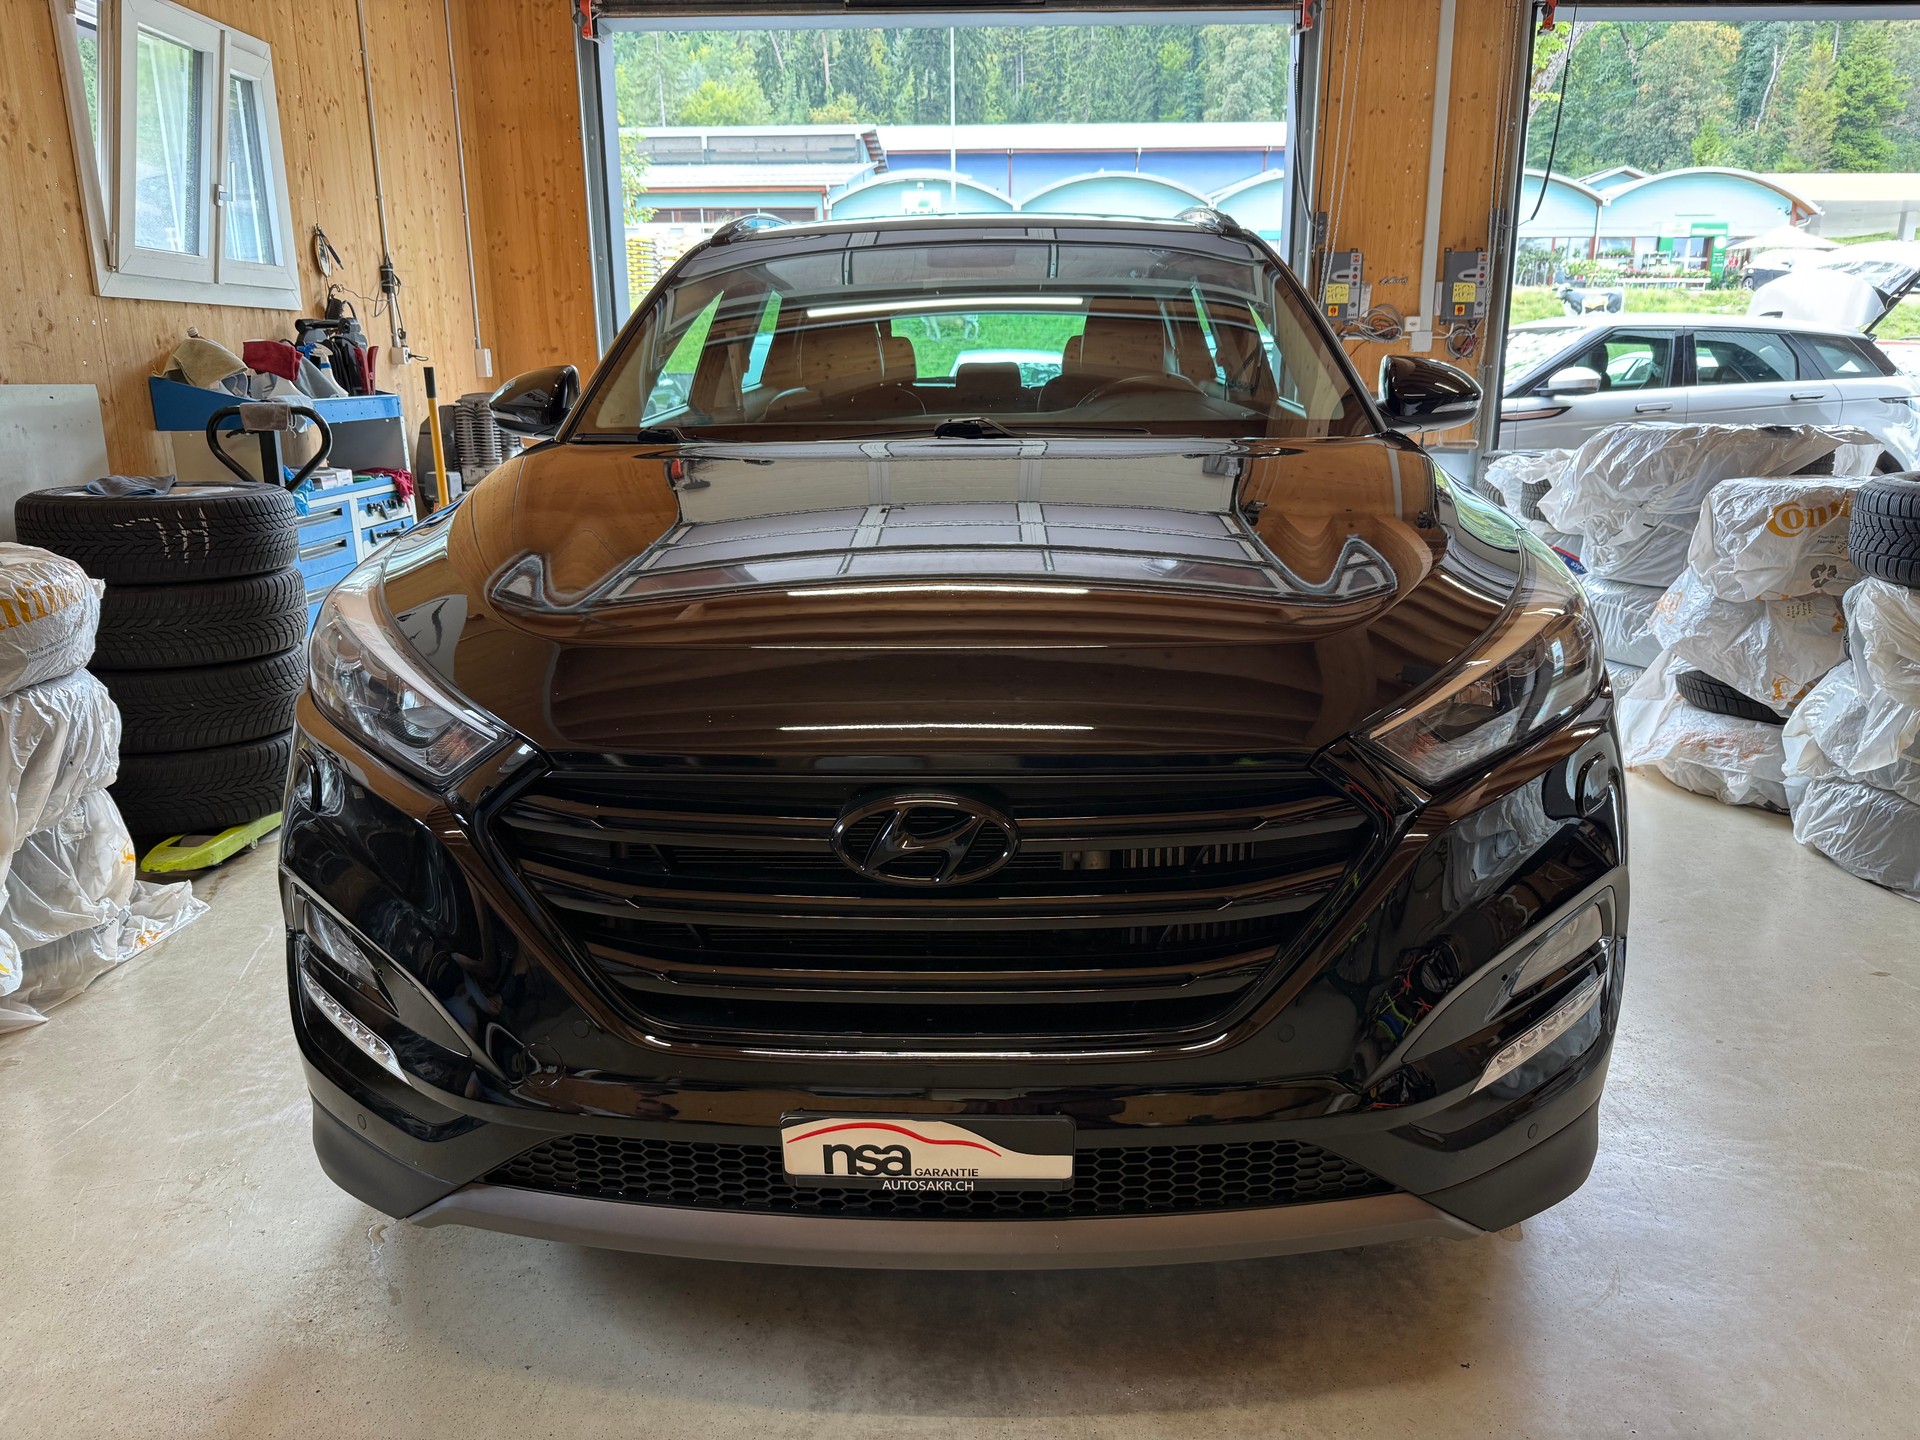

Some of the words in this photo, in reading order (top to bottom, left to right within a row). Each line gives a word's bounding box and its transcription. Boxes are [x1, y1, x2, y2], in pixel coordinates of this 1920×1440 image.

[822, 1143, 912, 1177] nsa
[914, 1168, 979, 1177] GARANTIE
[882, 1180, 974, 1191] AUTOSAKR.CH
